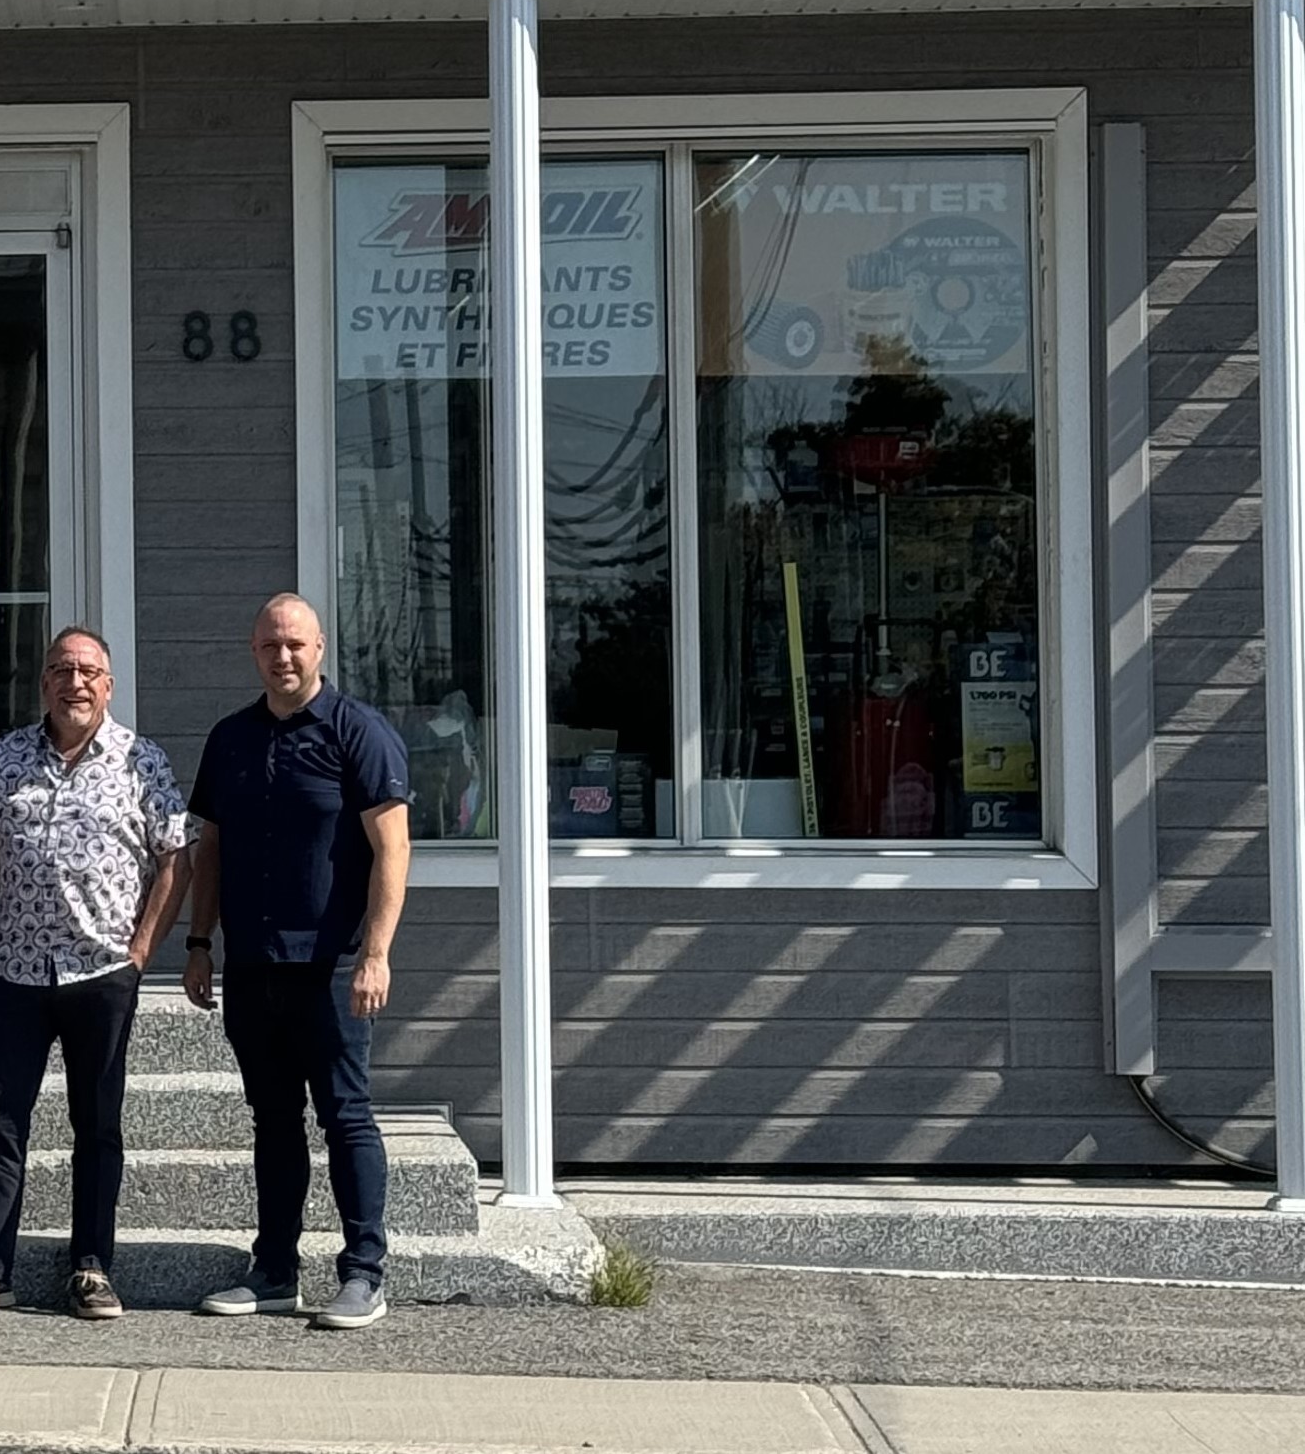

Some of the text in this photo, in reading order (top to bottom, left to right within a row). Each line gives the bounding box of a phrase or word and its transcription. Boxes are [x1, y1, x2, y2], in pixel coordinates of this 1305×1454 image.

[772, 181, 1007, 215] WALTER
[375, 185, 639, 248] AMOIL
[923, 236, 1000, 248] WALTER
[350, 301, 656, 333] SYNTHQUES
[182, 310, 261, 362] 88
[396, 339, 611, 369] ET FIRES
[968, 649, 1008, 678] BE
[971, 801, 1010, 829] BE
